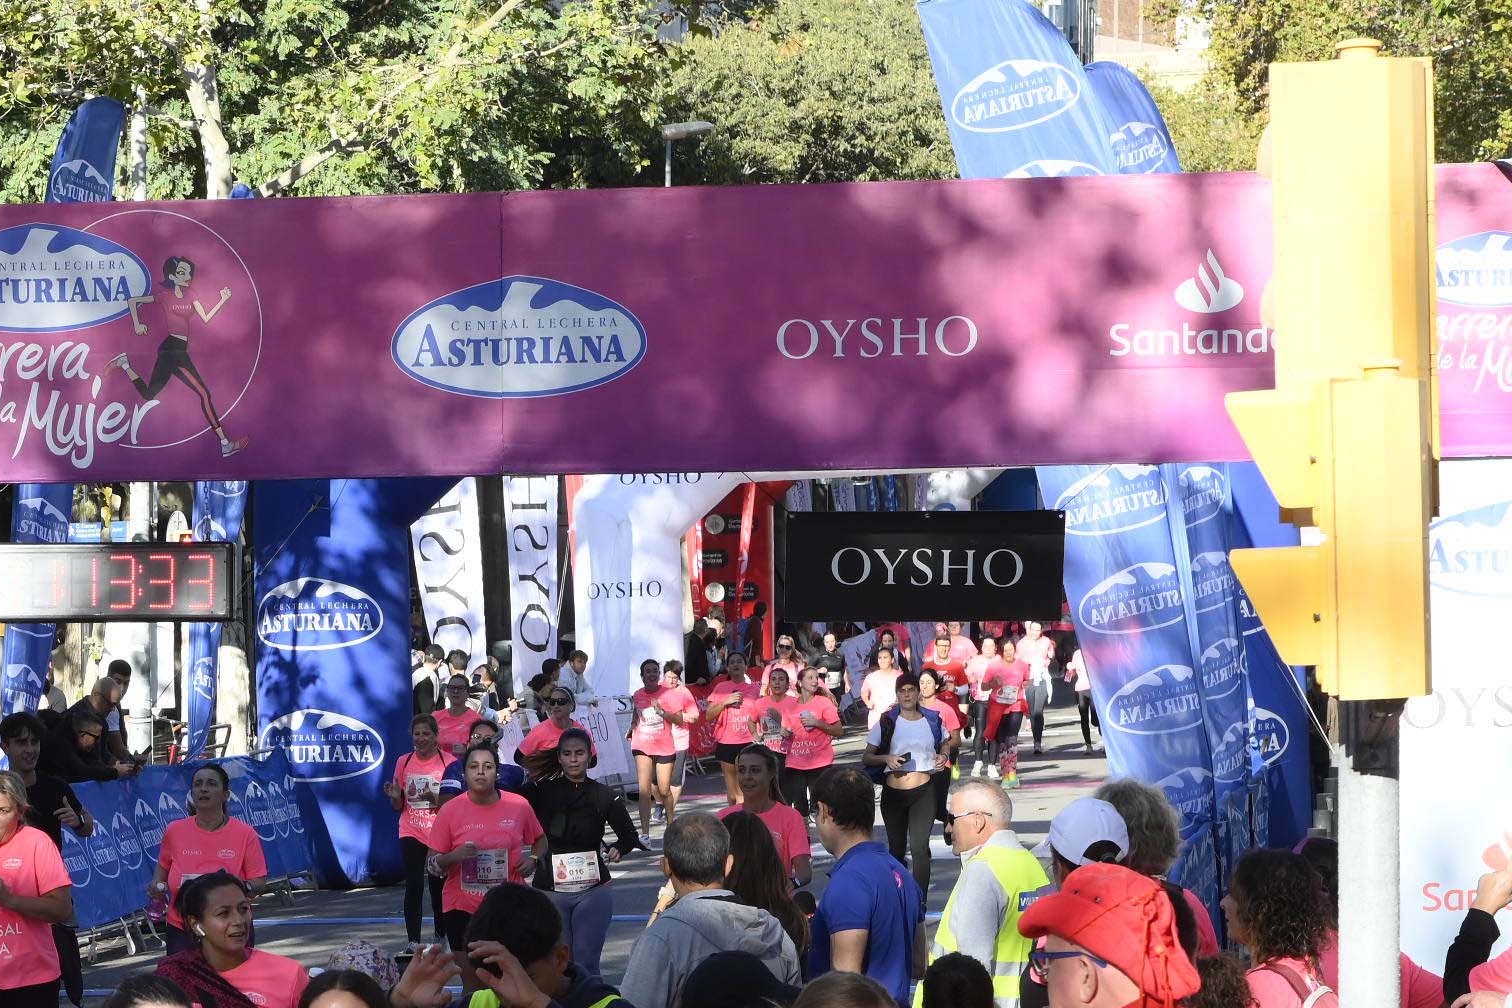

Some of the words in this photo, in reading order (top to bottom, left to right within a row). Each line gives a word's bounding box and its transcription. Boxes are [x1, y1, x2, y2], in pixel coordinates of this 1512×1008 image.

[53, 259, 126, 271] LECHERA
[450, 318, 529, 332] CENTRAL
[537, 315, 619, 330] LECHERA
[411, 323, 628, 369] ASTURIANA
[776, 315, 978, 360] OYSHO
[11, 375, 161, 469] Mujer
[831, 547, 1024, 587] OYSHO
[588, 580, 662, 600] OYSHO
[320, 601, 369, 610] LECHERA
[260, 607, 374, 635] ASTURIANA
[276, 733, 317, 742] CENTRAL
[321, 733, 370, 742] LECHERA
